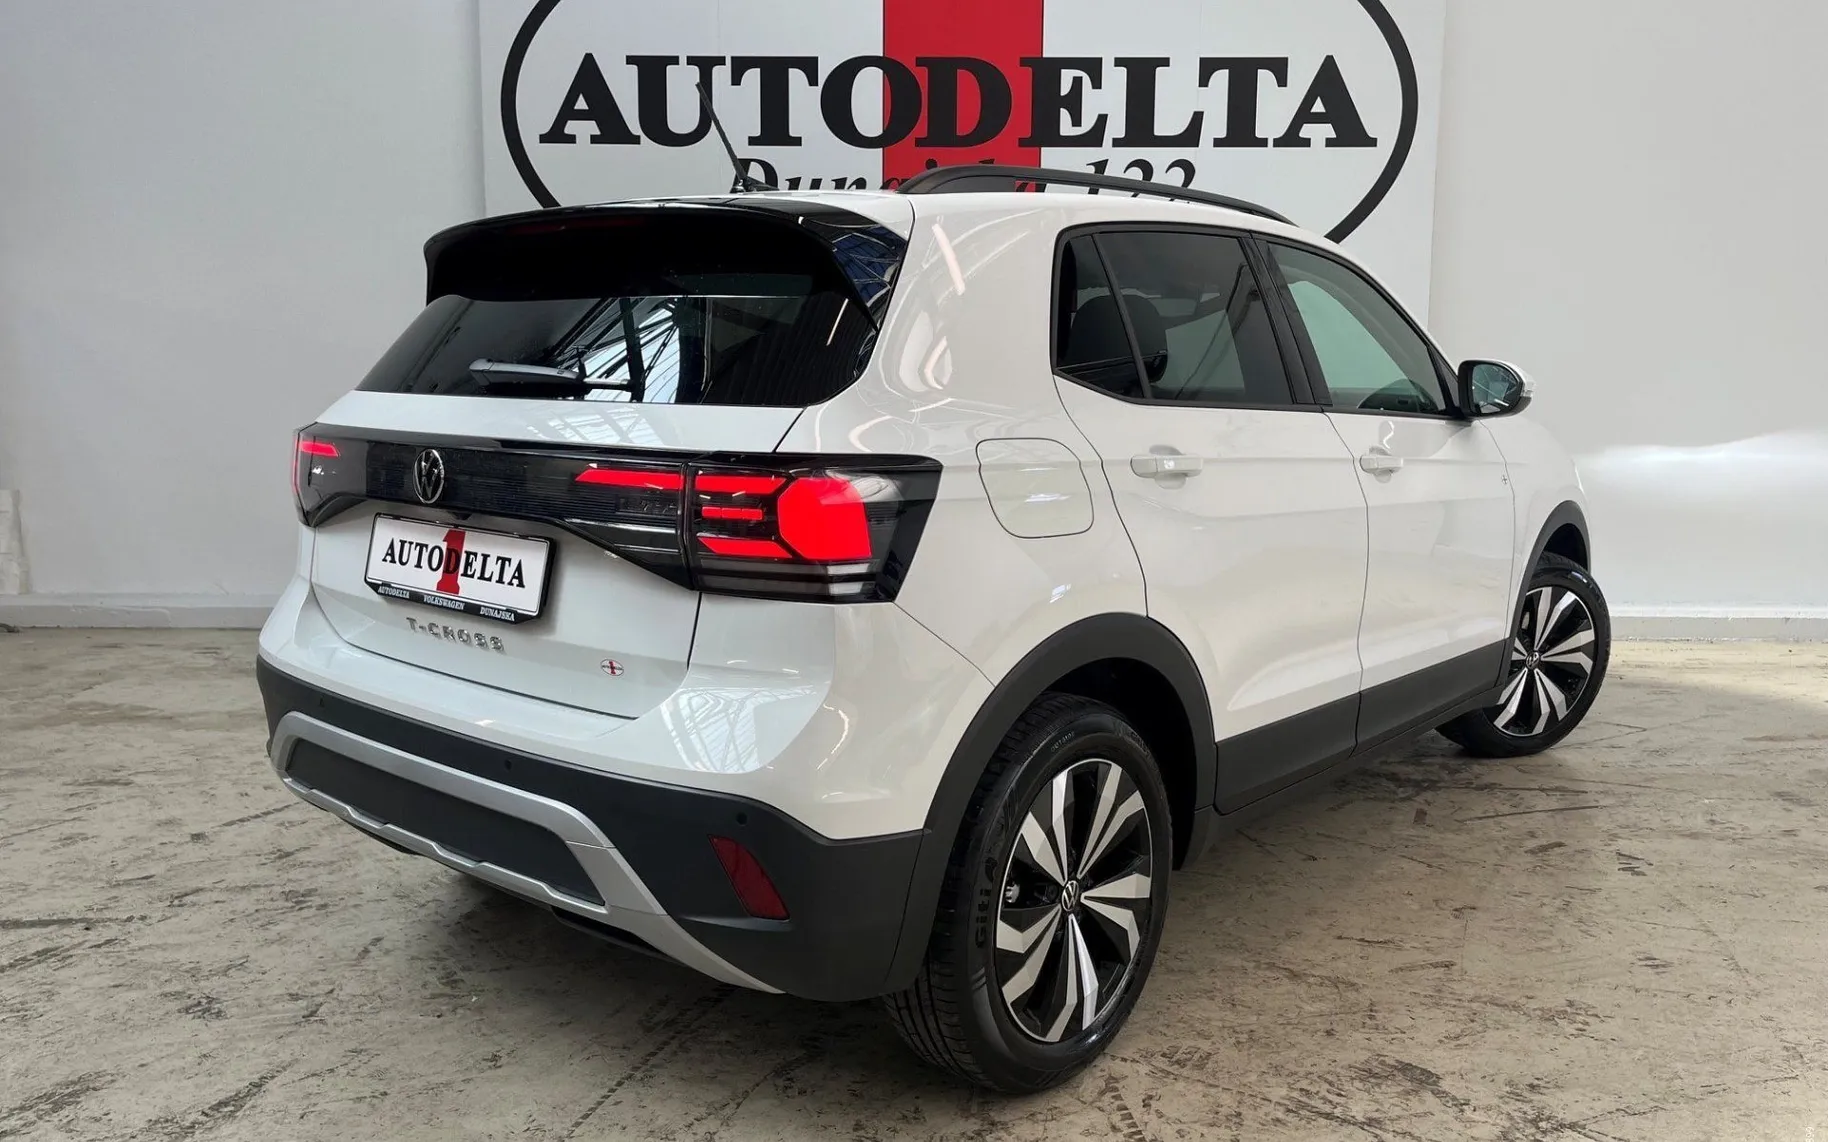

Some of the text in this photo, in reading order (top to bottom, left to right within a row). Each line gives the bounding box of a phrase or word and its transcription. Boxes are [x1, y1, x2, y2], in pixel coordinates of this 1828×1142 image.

[539, 52, 1378, 149] AUTODELTA
[381, 537, 526, 589] AUTODELTA
[377, 586, 515, 622] AUTODELTA VOLKSWAGEN DUNAJSKA
[406, 617, 506, 653] T-CROSS
